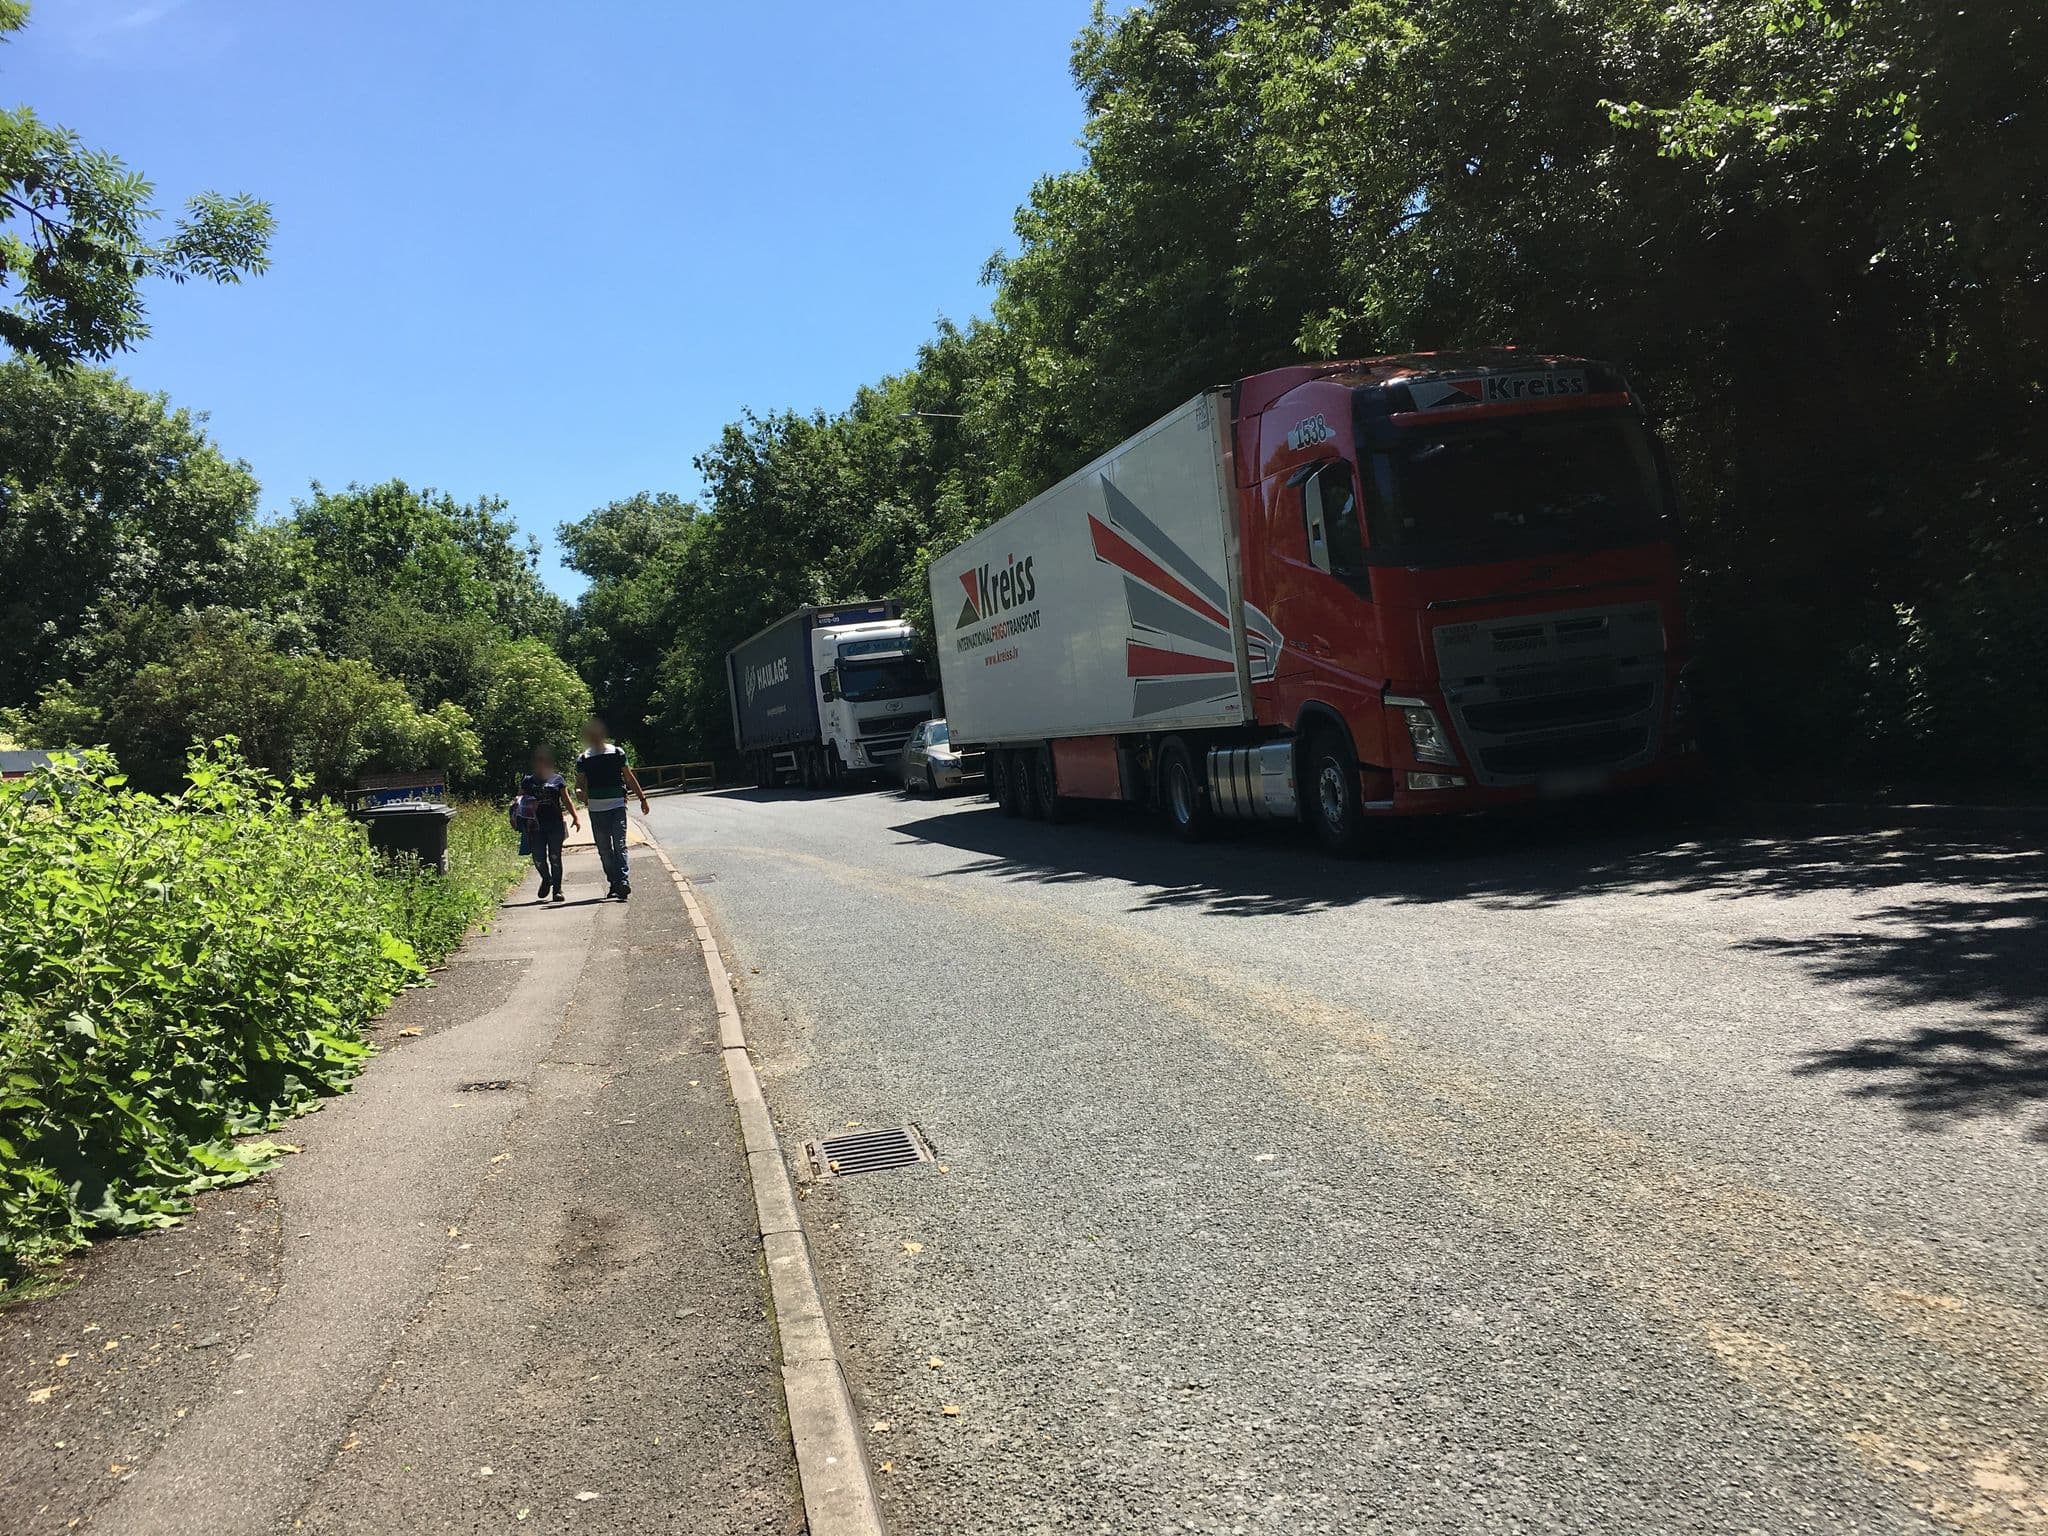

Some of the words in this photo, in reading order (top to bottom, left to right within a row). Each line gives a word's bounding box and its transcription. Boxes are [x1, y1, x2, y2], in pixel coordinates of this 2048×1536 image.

[1487, 374, 1583, 399] Kreiss
[1294, 414, 1327, 449] 1538
[978, 553, 1035, 617] Kreiss
[757, 657, 789, 690] HAULAGE
